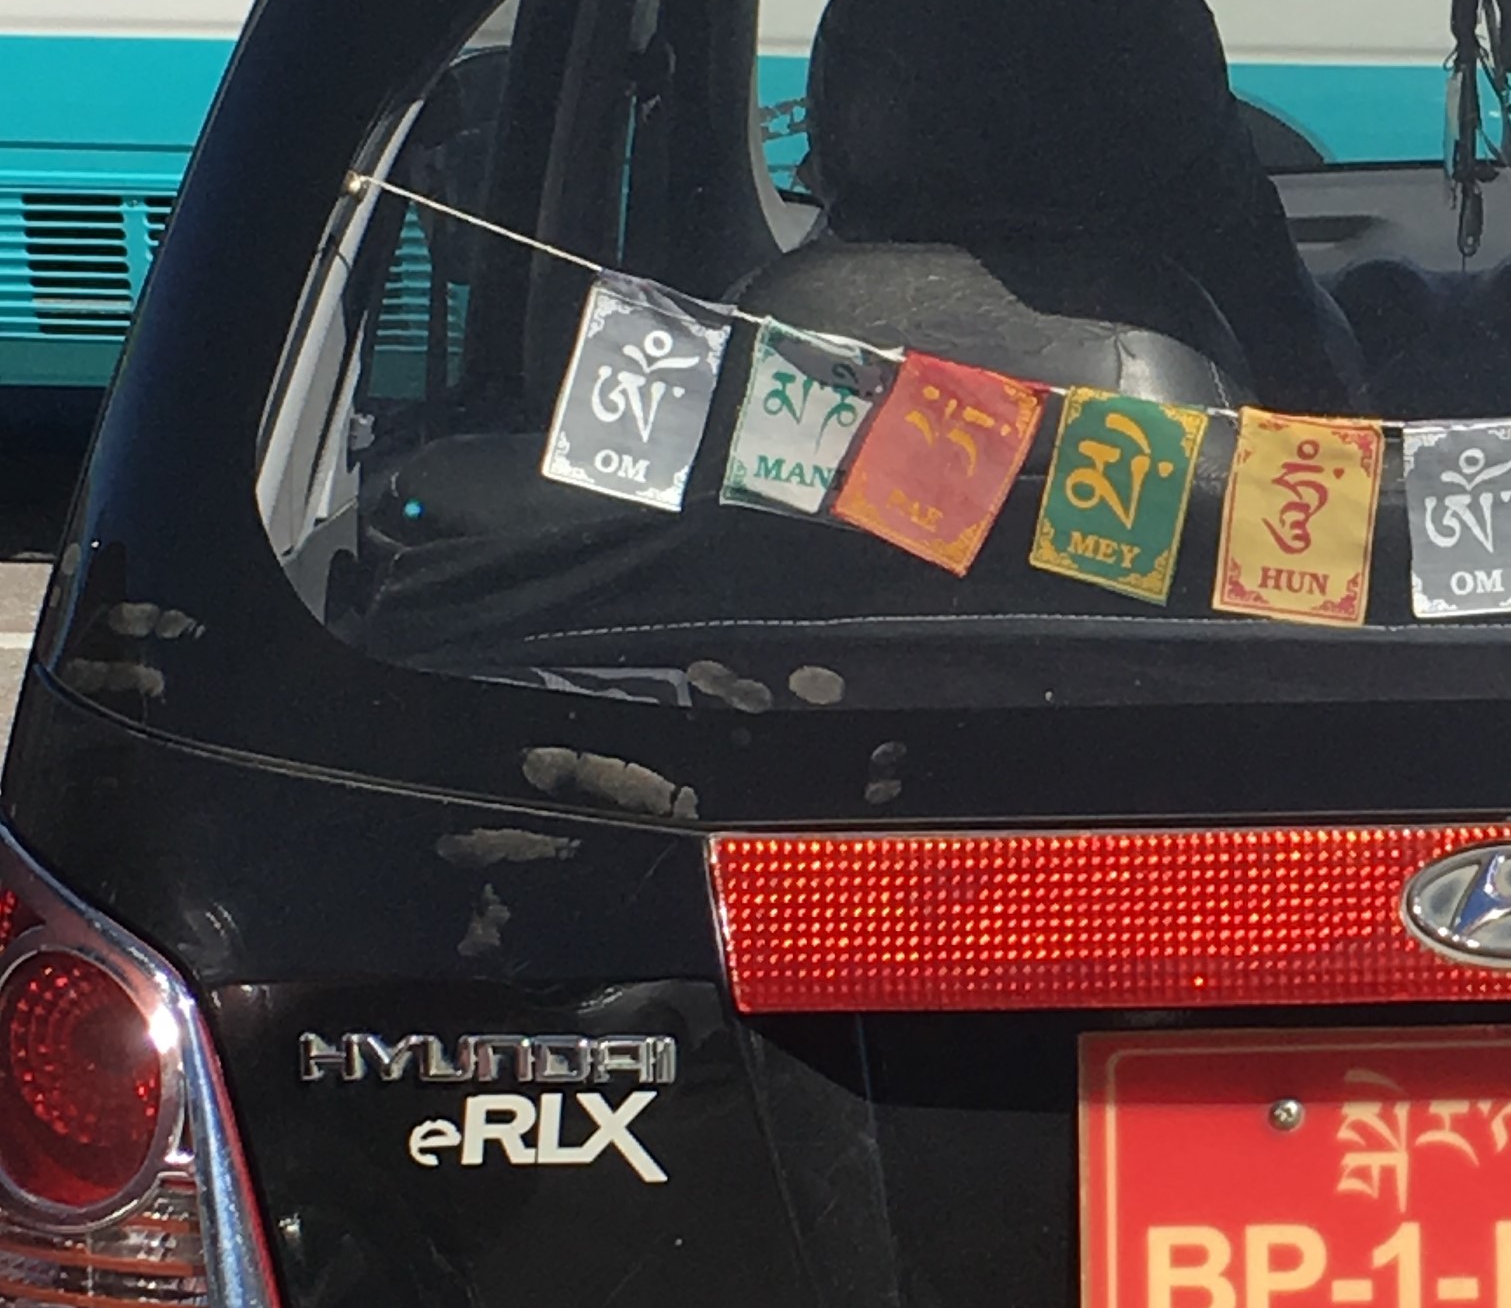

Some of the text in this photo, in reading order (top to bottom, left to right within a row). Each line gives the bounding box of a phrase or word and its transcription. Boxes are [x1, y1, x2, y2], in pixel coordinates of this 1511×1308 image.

[594, 449, 651, 484] OM
[1067, 531, 1141, 569] MEY
[1258, 566, 1330, 595] HUN
[1450, 569, 1505, 595] OM
[299, 1031, 678, 1084] HYUNDAI
[408, 1090, 669, 1184] eRLX
